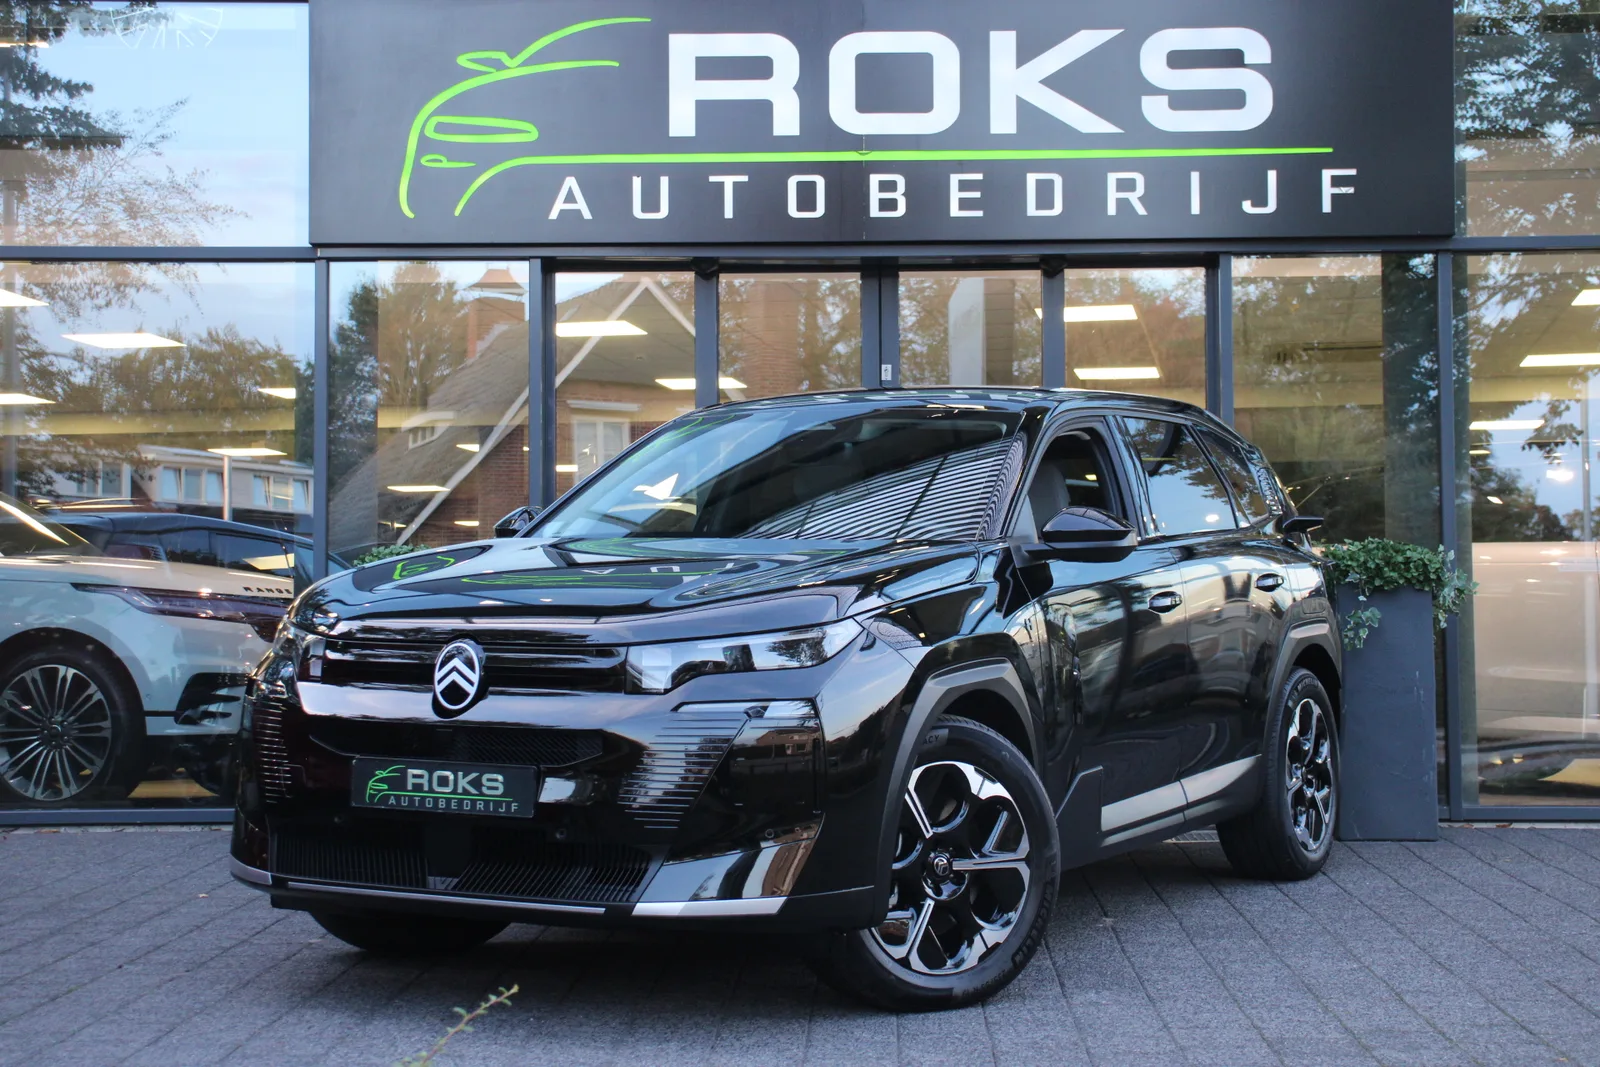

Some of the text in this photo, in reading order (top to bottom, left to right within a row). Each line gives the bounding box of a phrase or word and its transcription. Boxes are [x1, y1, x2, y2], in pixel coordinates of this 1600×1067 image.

[669, 27, 1274, 137] ROKS
[548, 168, 1357, 220] AUTOBEDRIJF
[407, 768, 504, 796] ROKS
[388, 795, 518, 813] AUTOBEDRIJF
